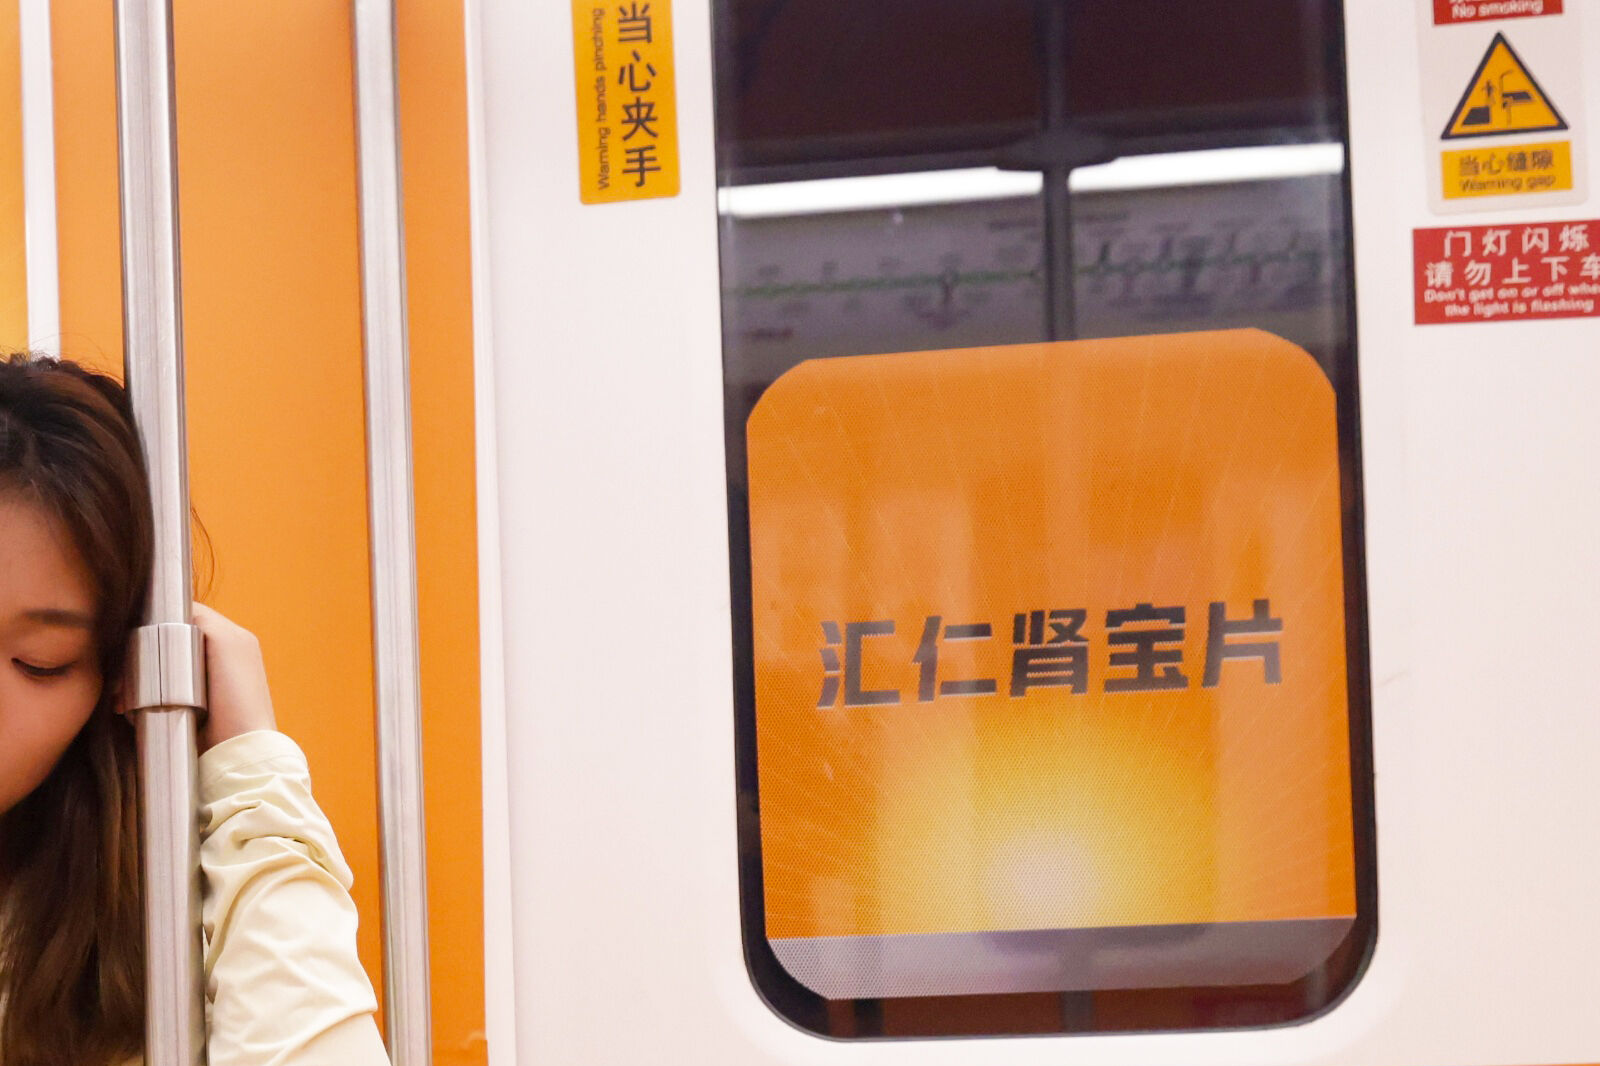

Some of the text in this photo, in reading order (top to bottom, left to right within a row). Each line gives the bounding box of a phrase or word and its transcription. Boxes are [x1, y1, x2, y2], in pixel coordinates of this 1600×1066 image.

[1452, 0, 1544, 18] No smoking
[592, 8, 611, 190] Warning hands pinching
[617, 1, 662, 188] 当心夹手
[1459, 150, 1554, 177] 当心缝隙
[1444, 224, 1590, 259] 门灯闪烁
[1424, 252, 1600, 288] 请勿上下车
[1424, 289, 1465, 303] Don't
[1469, 288, 1494, 305] get
[1498, 287, 1518, 298] on
[1522, 286, 1539, 298] or
[1542, 282, 1565, 297] off
[1445, 303, 1470, 317] the
[1473, 300, 1509, 318] light
[1512, 301, 1527, 314] is
[816, 598, 1283, 709] 汇仁肾宝片
